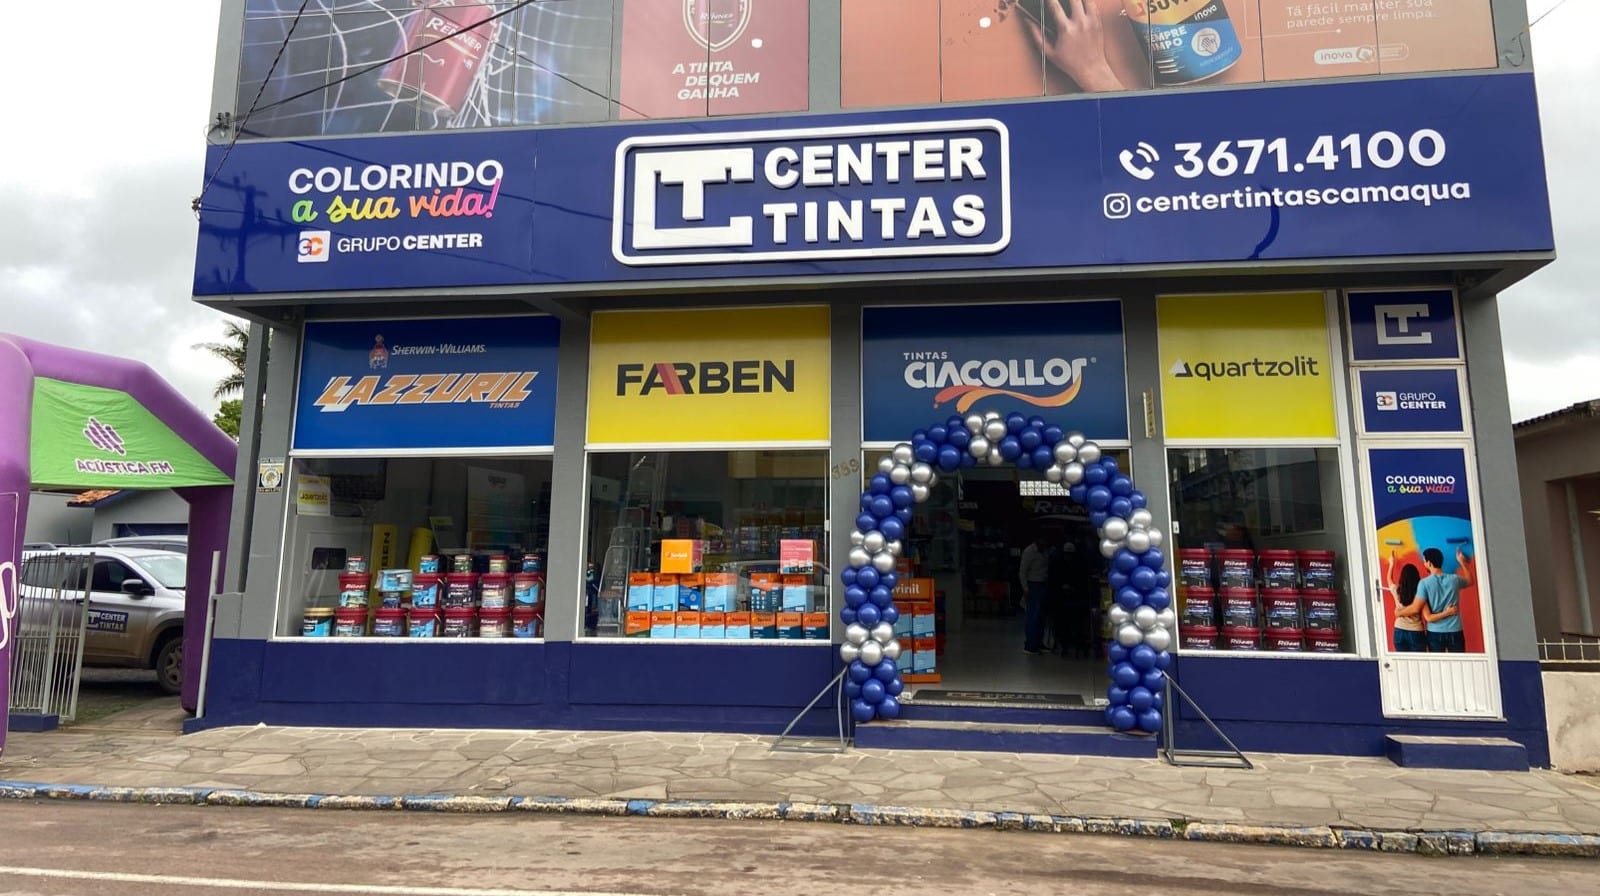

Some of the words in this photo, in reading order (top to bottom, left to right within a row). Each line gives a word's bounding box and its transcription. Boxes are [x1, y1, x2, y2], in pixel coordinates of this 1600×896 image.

[1194, 4, 1218, 21] inova
[1306, 3, 1339, 18] fácil
[1344, 0, 1399, 13] manter
[1406, 0, 1433, 8] sua
[1286, 16, 1335, 29] parede
[1338, 12, 1389, 24] sempre
[1320, 51, 1353, 61] inova
[672, 64, 685, 74] A
[689, 61, 734, 73] TINTA
[677, 87, 740, 100] GANHA
[1173, 128, 1446, 179] 3671.4100
[763, 137, 987, 189] CENTER
[288, 159, 504, 194] COLORINDO
[291, 199, 318, 223] a
[326, 194, 401, 223] sua
[409, 178, 501, 219] vida!
[1136, 182, 1471, 213] centertintascamaqua
[763, 194, 986, 244] TINTAS
[337, 236, 400, 253] GRUPO
[402, 233, 483, 250] CENTER
[903, 351, 948, 360] TINTAS
[1194, 356, 1319, 381] quartzolit
[616, 359, 795, 396] FARBEN
[313, 371, 539, 412] LAZZURIL
[1399, 392, 1436, 401] GRUPO
[1400, 400, 1447, 409] CENTER
[149, 461, 175, 474] FM
[1385, 475, 1456, 485] COLORINDO
[1387, 485, 1396, 494] a
[1399, 484, 1424, 494] sua
[1425, 483, 1455, 494] vida!
[1034, 500, 1089, 513] RENN
[101, 612, 126, 622] CENTER
[100, 622, 124, 631] TINTAS
